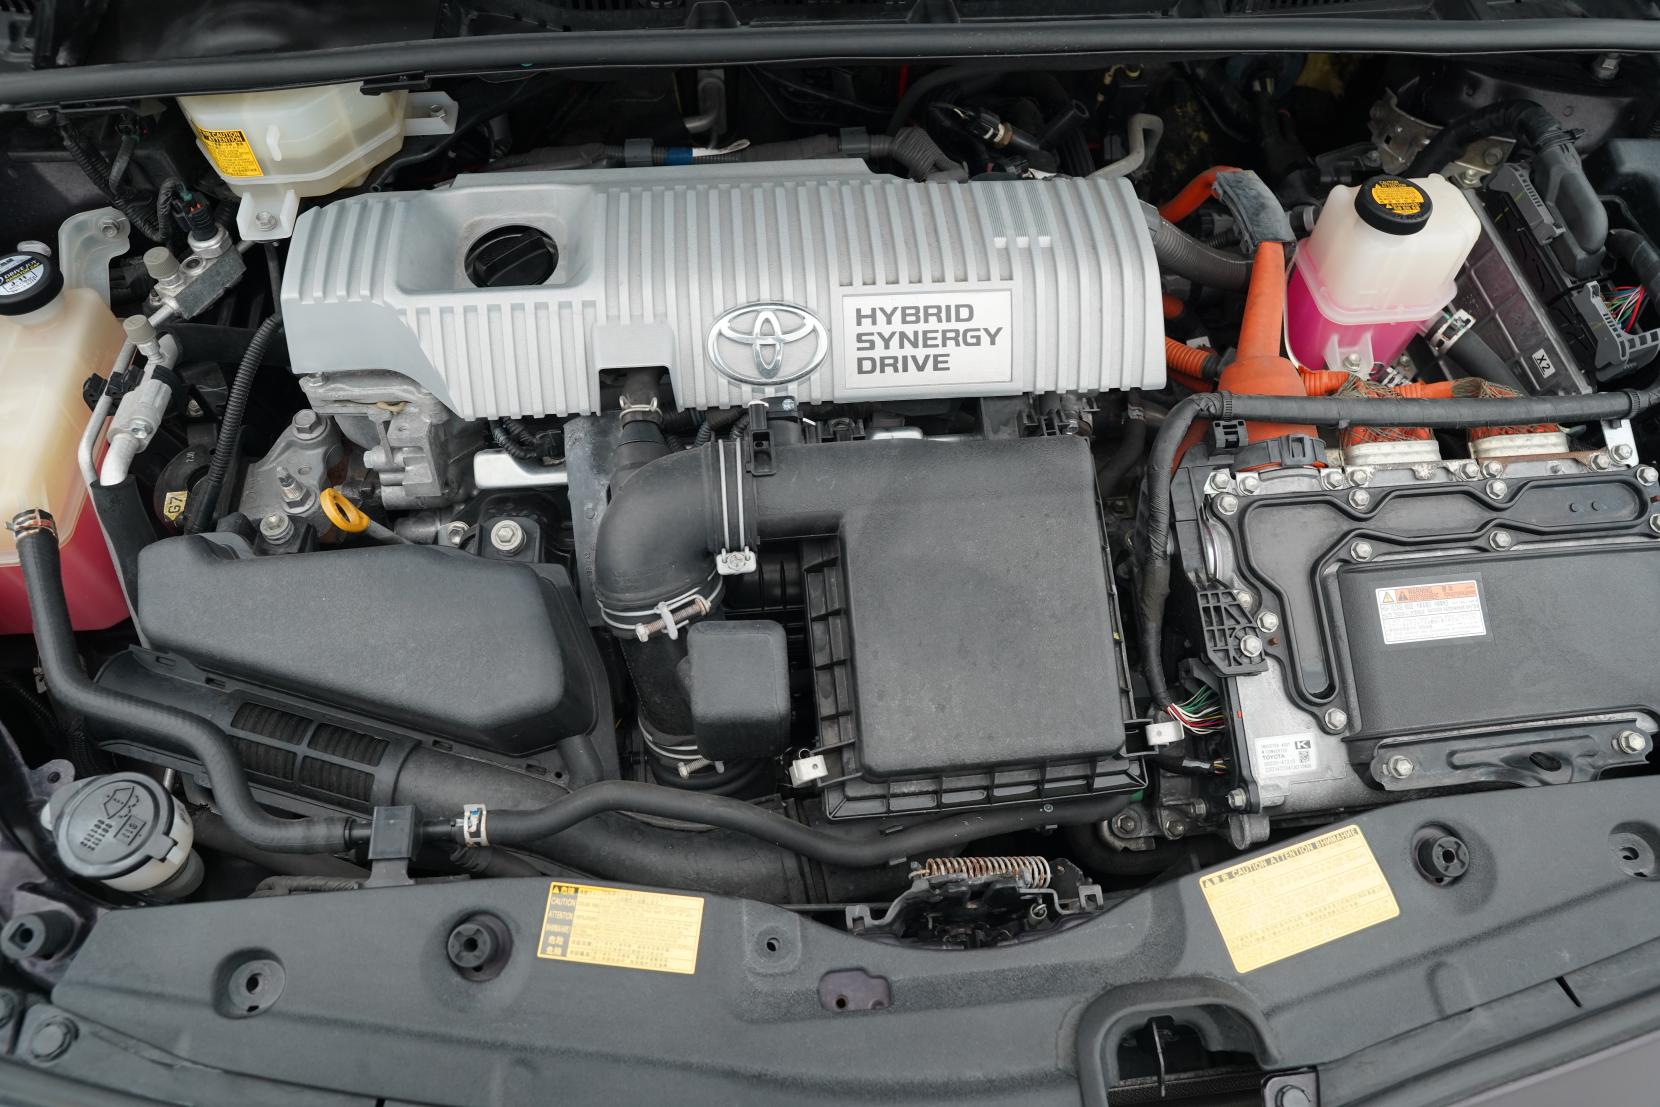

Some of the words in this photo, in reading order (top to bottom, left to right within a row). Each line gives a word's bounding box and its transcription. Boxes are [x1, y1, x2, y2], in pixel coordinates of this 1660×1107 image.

[4, 265, 25, 279] DRIVE
[855, 304, 974, 326] HYBRID
[856, 327, 1003, 351] SYNERGY
[856, 353, 951, 375] DRIVE
[168, 496, 183, 513] G7
[1231, 859, 1266, 878] CAUTION
[1270, 843, 1314, 866] ATTENTION
[550, 896, 576, 906] CAUTION
[548, 910, 573, 921] ATTENTION
